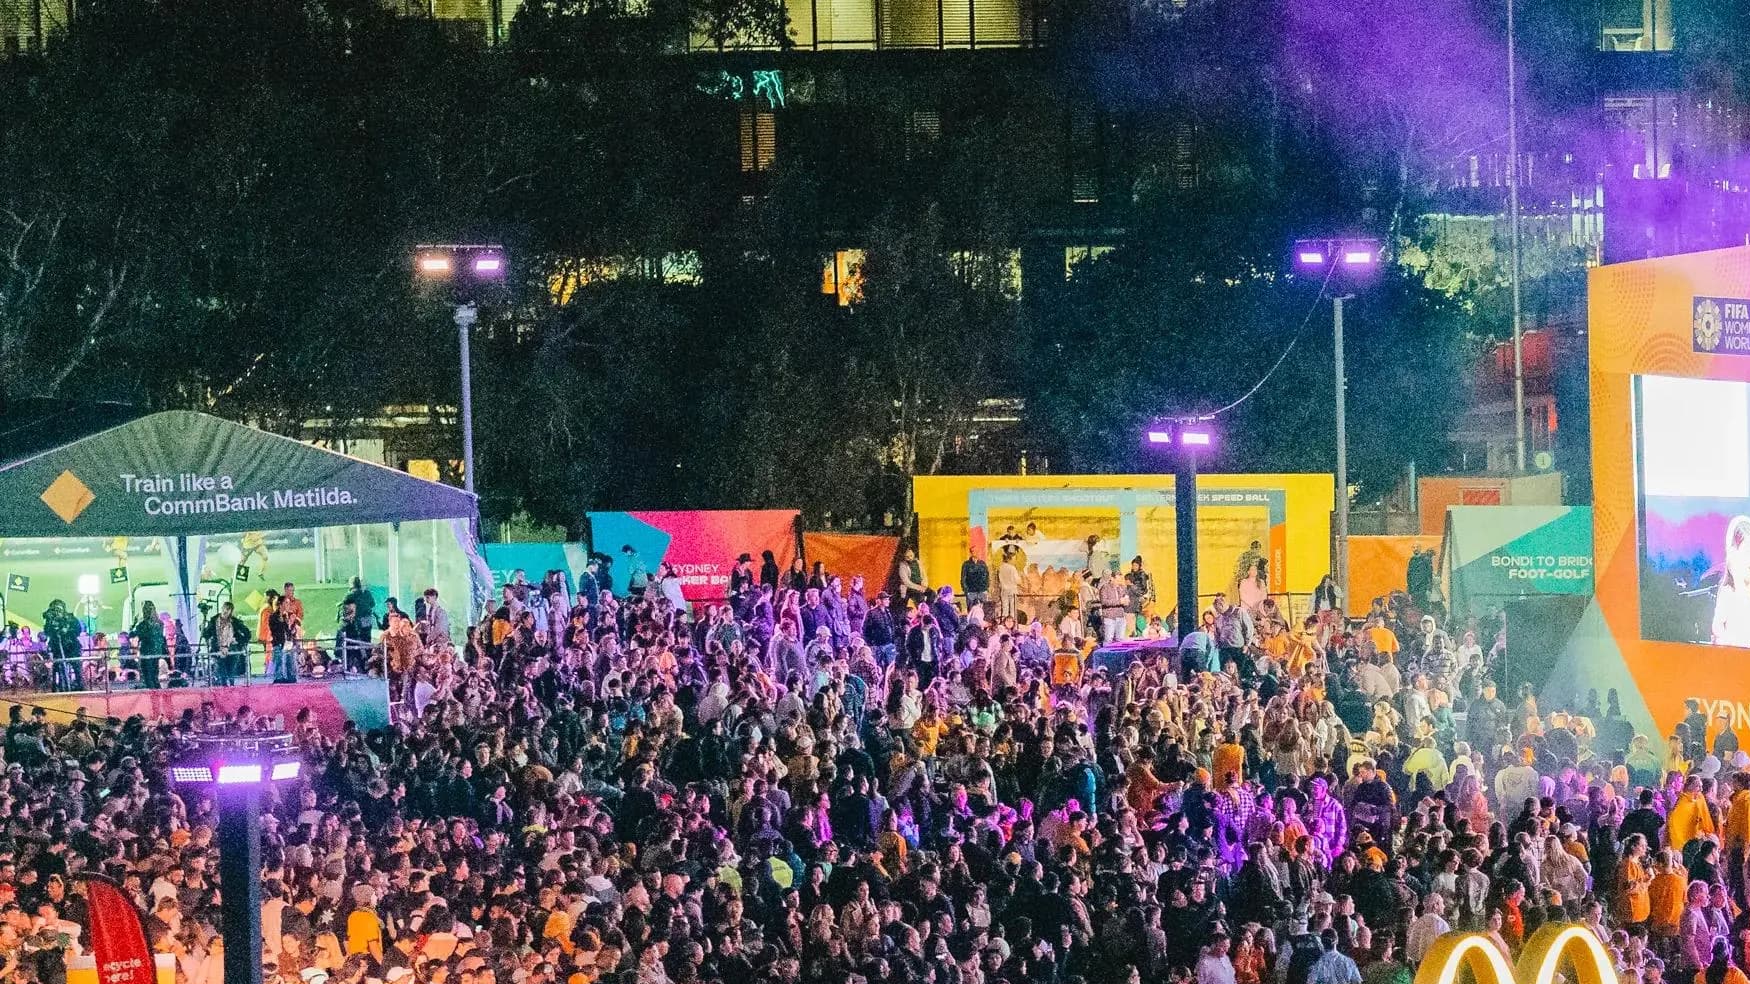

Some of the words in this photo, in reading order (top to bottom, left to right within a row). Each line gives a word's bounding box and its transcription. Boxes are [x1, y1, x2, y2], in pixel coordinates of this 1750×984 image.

[1724, 303, 1749, 320] FIFA
[119, 473, 174, 494] Train
[179, 473, 216, 492] like
[220, 475, 234, 491] a
[144, 492, 270, 516] CommBank
[273, 487, 358, 509] Matilda.
[1211, 493, 1244, 502] SPEED
[1245, 493, 1271, 502] BALL
[1491, 556, 1533, 567] BONDI
[1537, 556, 1555, 566] TO
[671, 563, 719, 574] SYDNEY
[1508, 568, 1590, 579] FOOT-GOLF
[102, 957, 142, 972] ecycle
